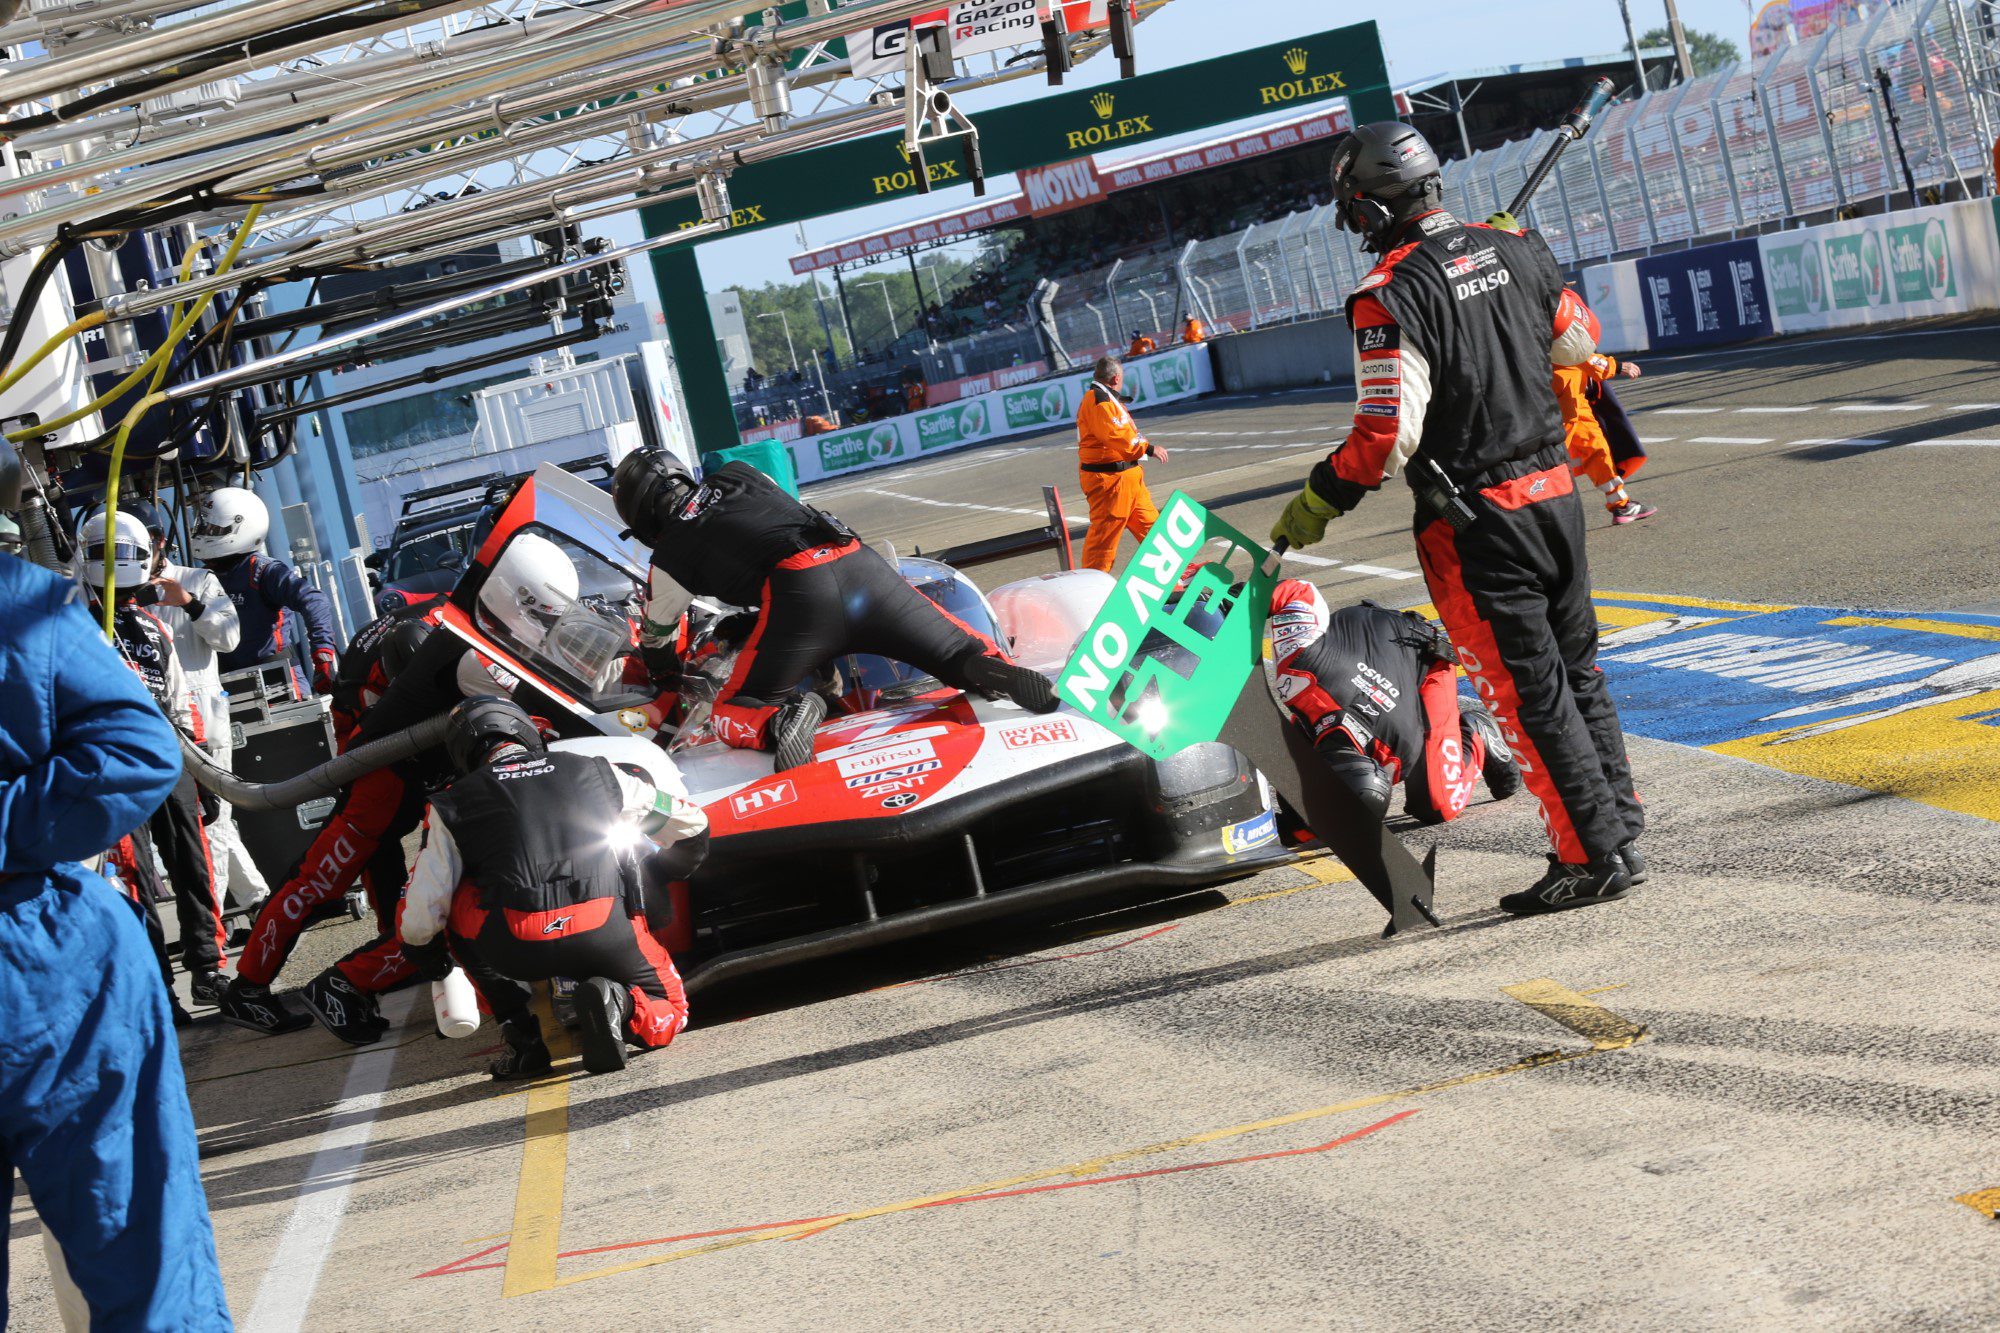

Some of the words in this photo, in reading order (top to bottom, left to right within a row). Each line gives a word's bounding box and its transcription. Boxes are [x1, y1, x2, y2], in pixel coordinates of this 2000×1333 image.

[955, 14, 1035, 40] Racing
[956, 0, 1036, 26] GAZOO
[1260, 71, 1348, 105] ROLEX
[1066, 114, 1154, 150] ROLEX
[1025, 160, 1100, 211] MOTUL
[1828, 244, 1860, 282] Sarthe
[1890, 234, 1923, 273] Sarthe
[1456, 268, 1510, 301] DENSO
[1361, 363, 1394, 374] Acronis
[1005, 391, 1039, 416] Sarthe
[920, 413, 956, 437] Sarthe
[823, 435, 865, 459] Sarthe
[399, 521, 478, 550] PORSC
[1125, 497, 1205, 626] DRV
[1065, 621, 1129, 713] ON
[1356, 661, 1401, 699] DENSO
[1005, 722, 1066, 737] HYPER
[1009, 728, 1072, 747] CAR
[497, 764, 556, 781] DENSO
[850, 747, 922, 770] FUJITSU
[734, 782, 787, 814] HY
[859, 773, 930, 799] ZENT
[283, 835, 357, 920] DENSO
